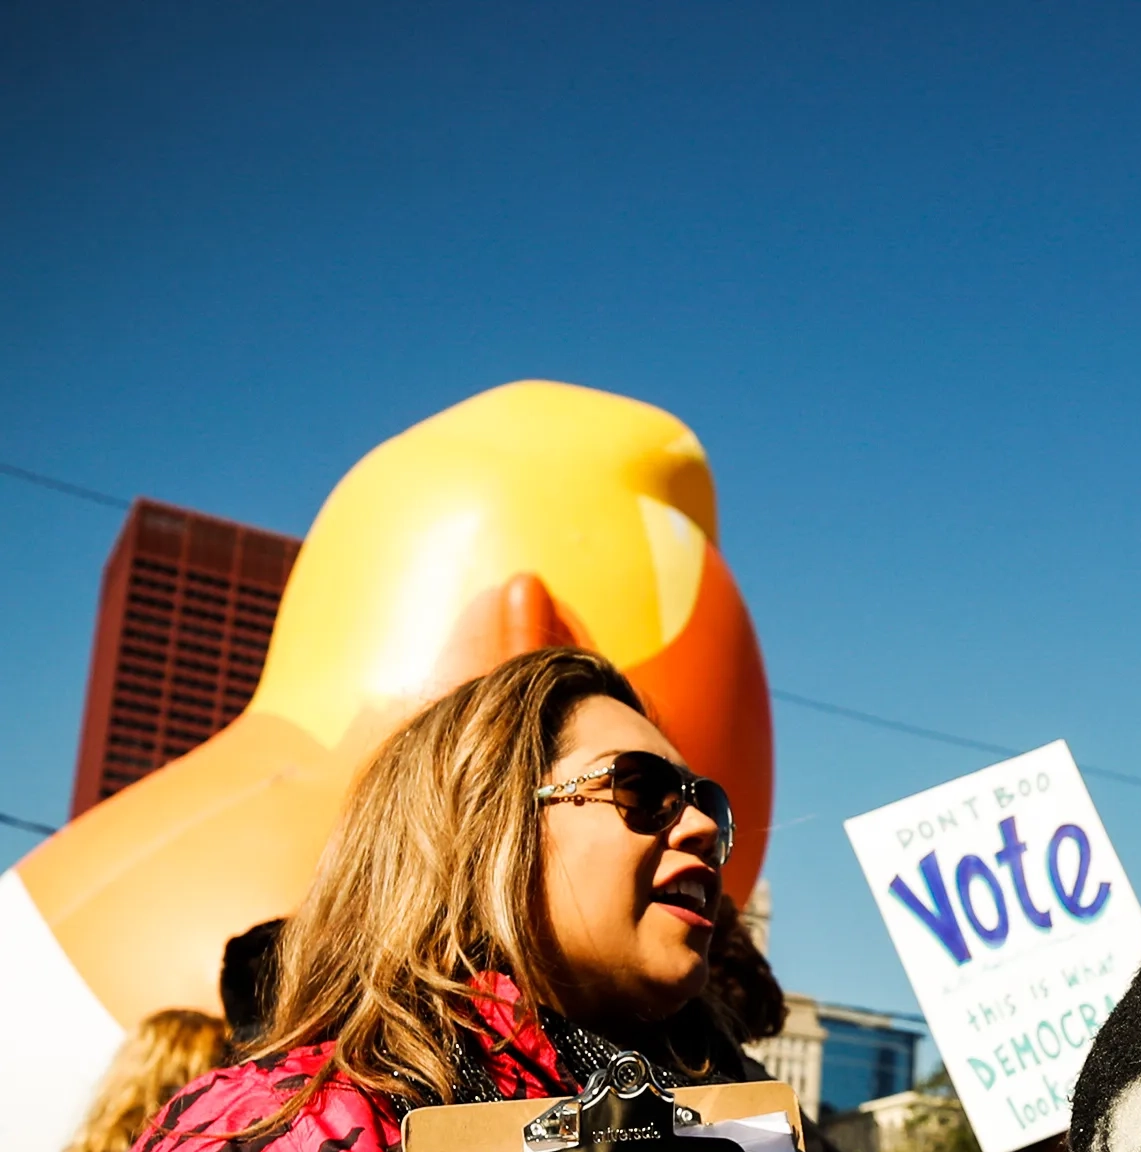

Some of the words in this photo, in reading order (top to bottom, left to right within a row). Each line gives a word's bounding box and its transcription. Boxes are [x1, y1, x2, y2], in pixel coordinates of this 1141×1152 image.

[993, 772, 1051, 808] BOO
[888, 815, 1112, 967] Vote
[966, 994, 1016, 1032] this
[1029, 976, 1050, 1000] is
